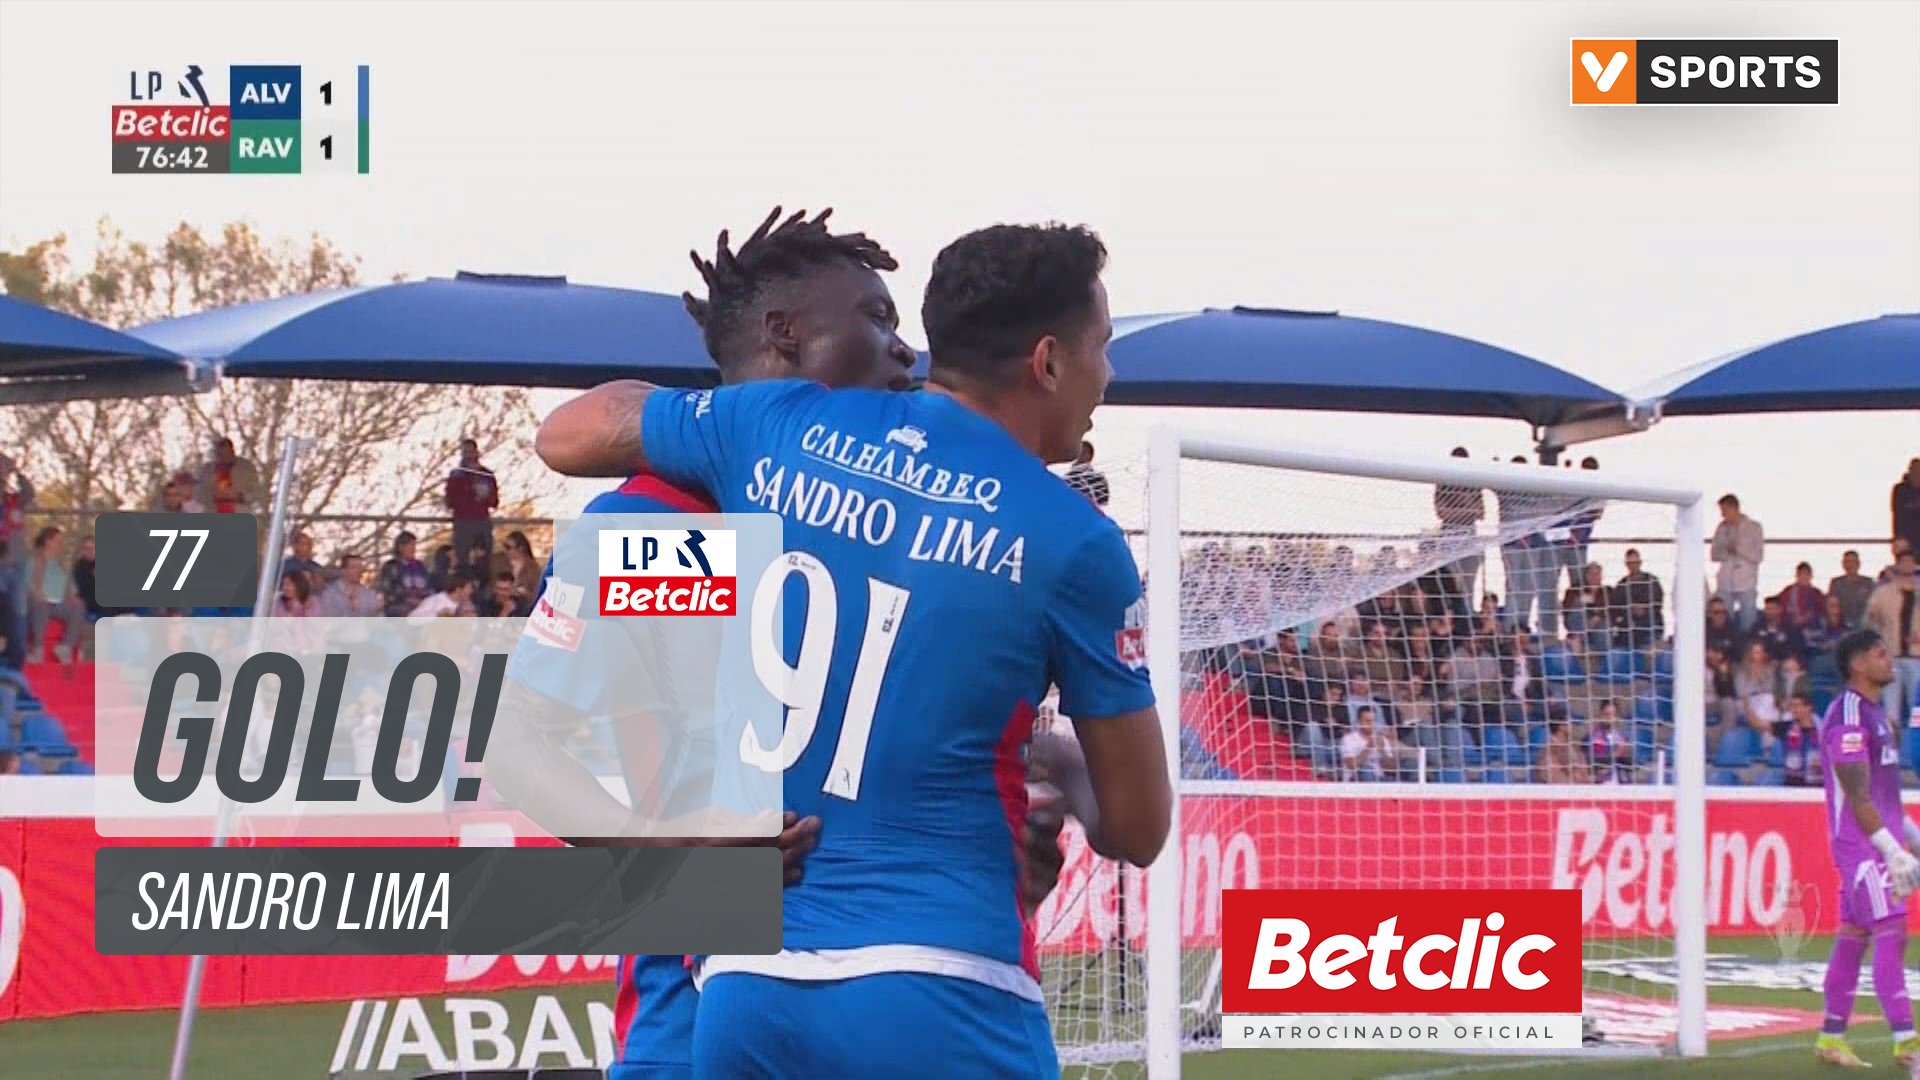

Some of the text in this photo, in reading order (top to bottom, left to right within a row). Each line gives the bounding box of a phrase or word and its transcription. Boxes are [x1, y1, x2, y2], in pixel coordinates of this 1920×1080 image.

[745, 456, 1026, 585] SANDRO LIMA
[801, 423, 1002, 512] CALHAMBEQ
[739, 550, 911, 801] 91
[1552, 807, 1792, 929] Betno
